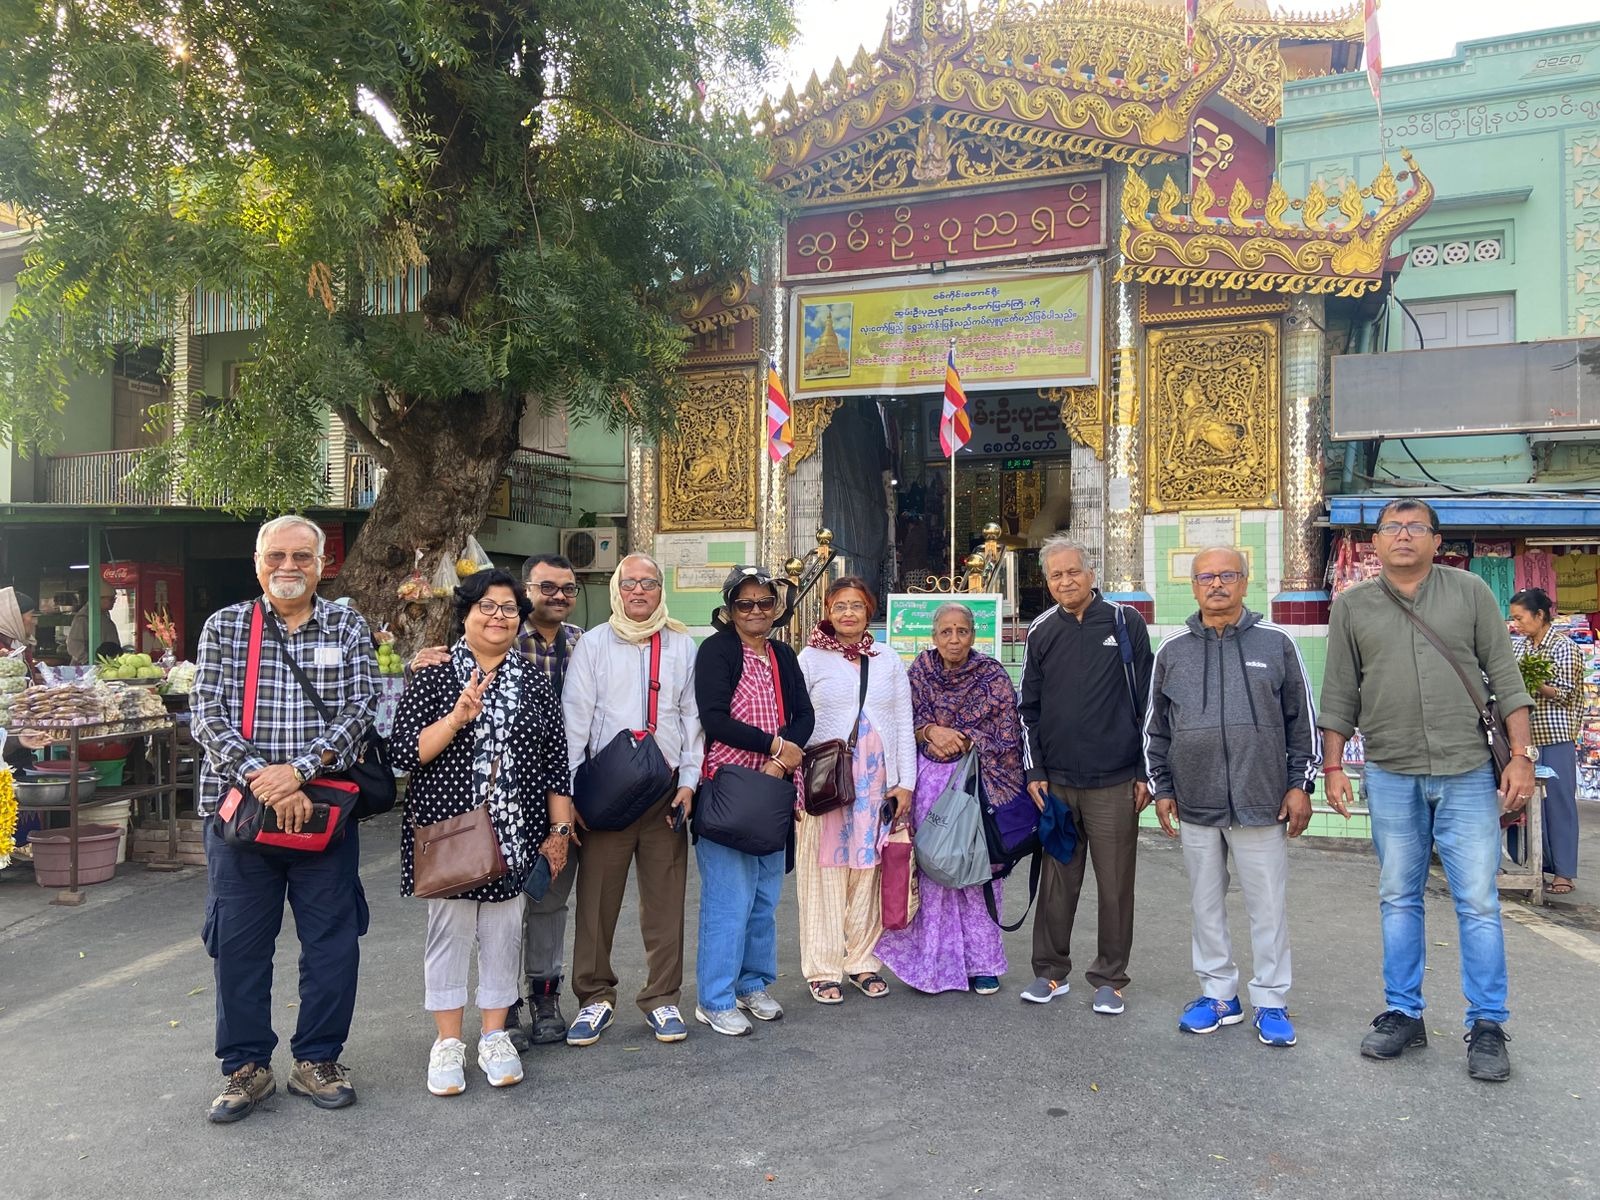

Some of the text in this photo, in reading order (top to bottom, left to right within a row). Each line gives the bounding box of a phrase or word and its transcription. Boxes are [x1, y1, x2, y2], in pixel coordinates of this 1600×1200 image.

[1534, 94, 1600, 120] ဟင်းရွ
[983, 432, 1057, 453] စေတီတော်
[1245, 661, 1268, 669] adidas
